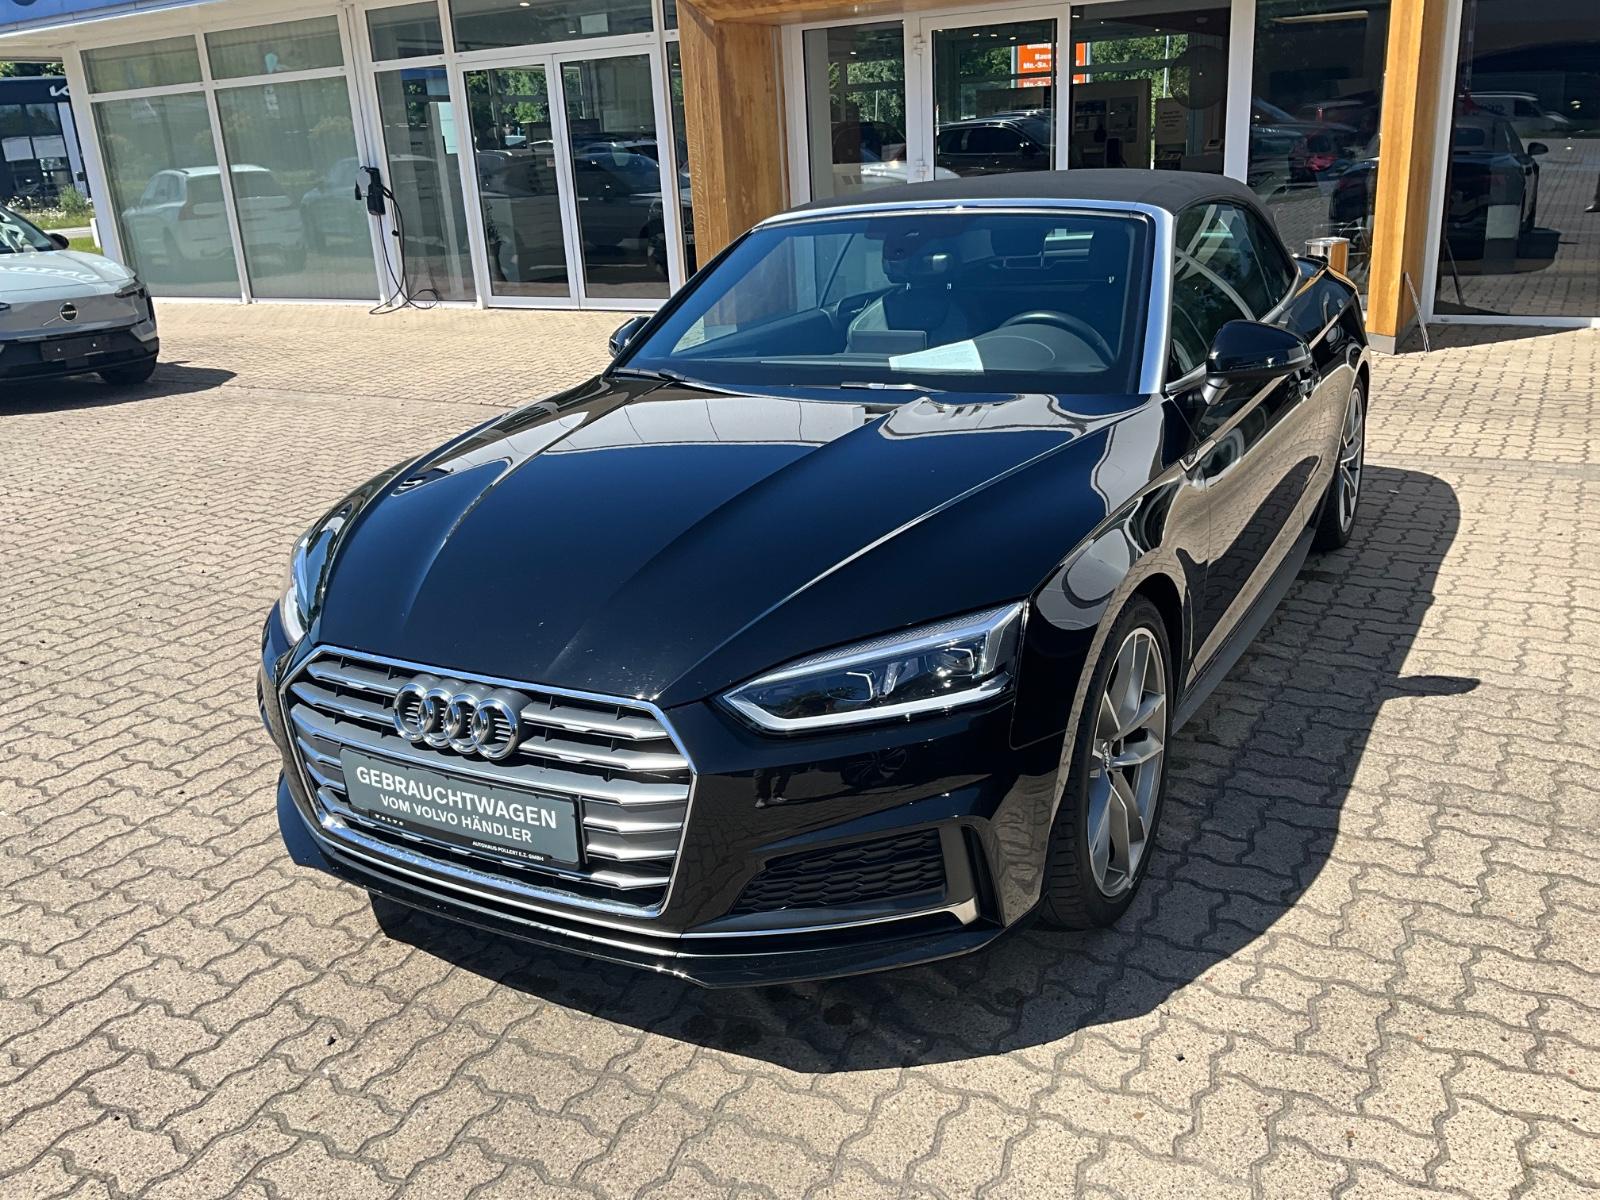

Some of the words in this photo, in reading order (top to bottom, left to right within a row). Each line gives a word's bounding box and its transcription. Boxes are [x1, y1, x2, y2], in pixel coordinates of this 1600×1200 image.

[355, 766, 557, 829] GEBRAUCHTWAGEN
[374, 813, 404, 826] VOLVO
[380, 793, 411, 814] VOM
[413, 803, 458, 825] VOLVO
[461, 814, 533, 844] HÄNDLER
[472, 841, 498, 851] AUTOHAUS
